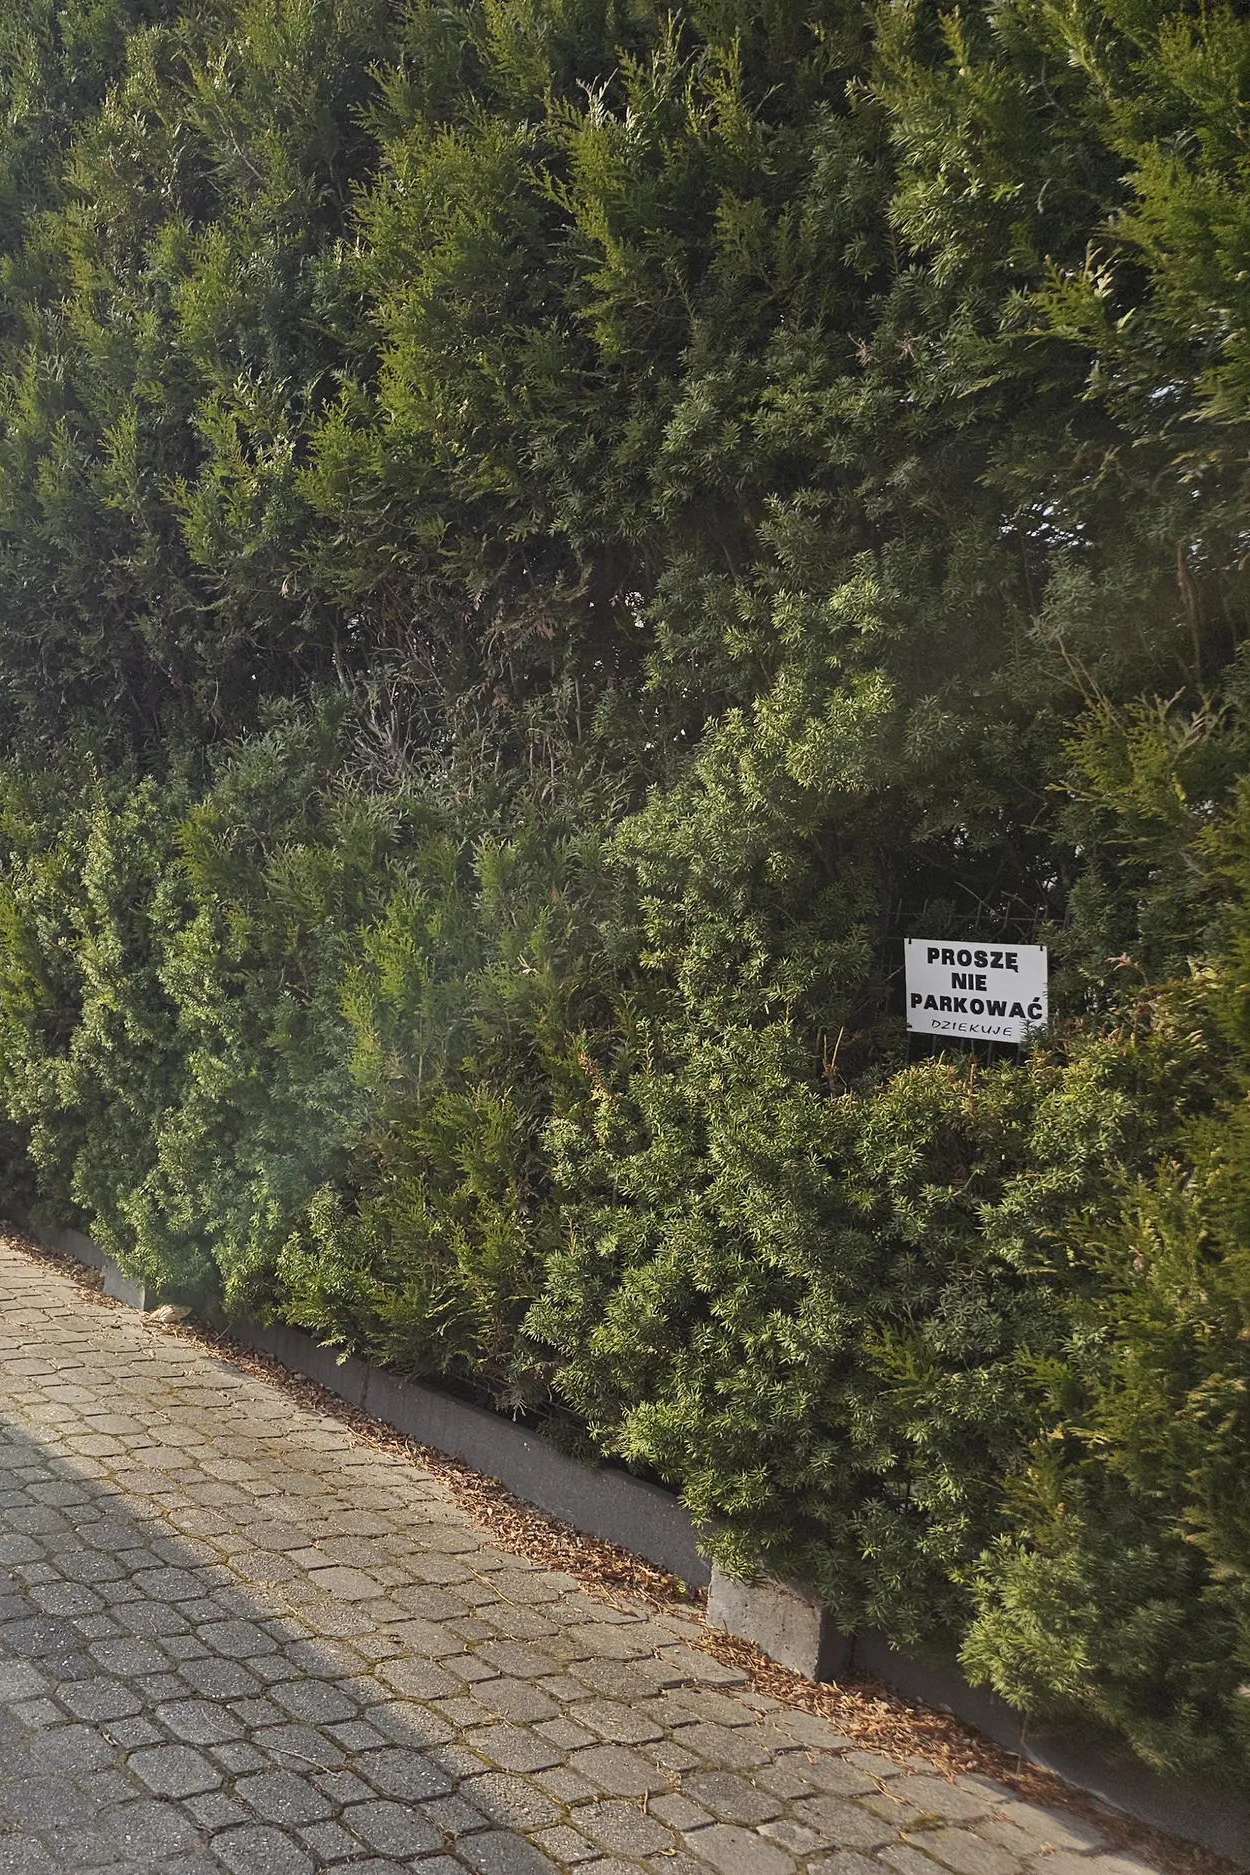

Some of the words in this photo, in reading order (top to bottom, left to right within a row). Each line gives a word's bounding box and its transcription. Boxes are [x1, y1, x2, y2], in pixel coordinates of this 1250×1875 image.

[927, 947, 1019, 973] PROSZĘ
[952, 972, 987, 991] NIE
[910, 992, 1043, 1020] PARKOWAĆ
